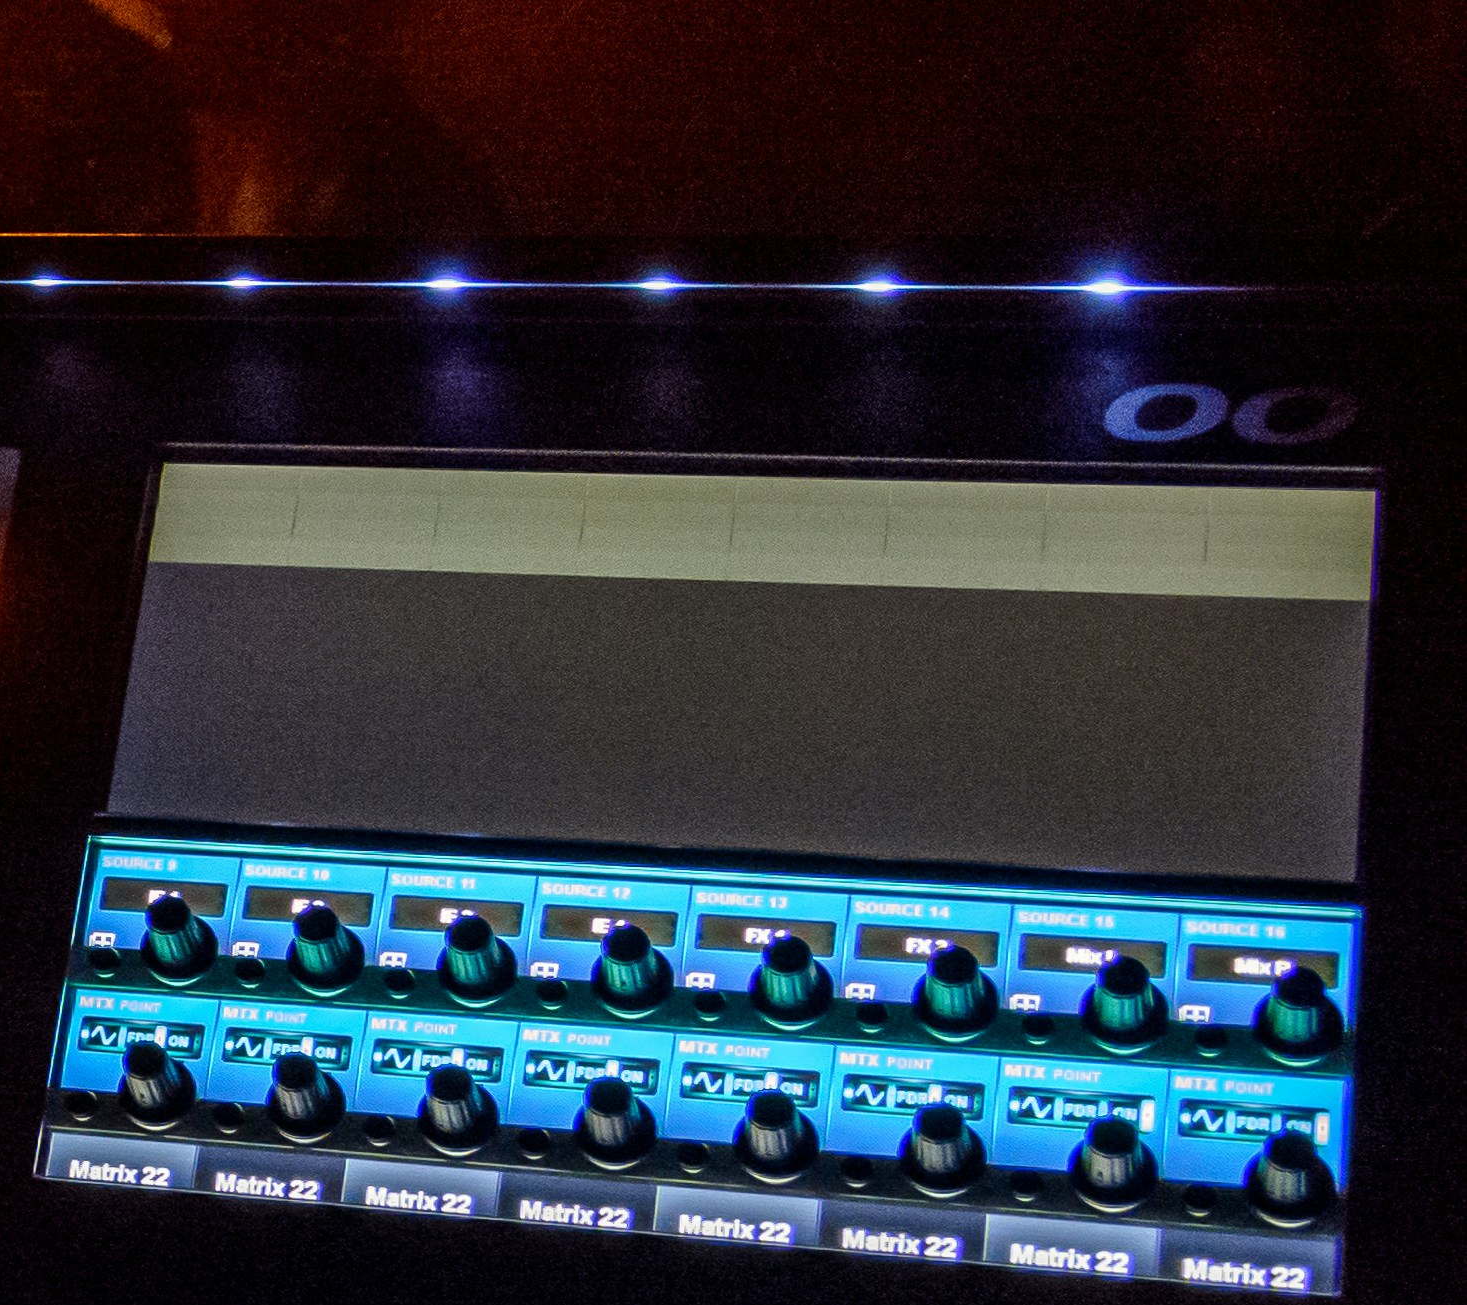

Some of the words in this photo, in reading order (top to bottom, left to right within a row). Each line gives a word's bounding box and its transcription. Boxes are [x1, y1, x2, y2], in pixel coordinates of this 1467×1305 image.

[102, 856, 165, 871] SOURCE
[167, 860, 178, 872] 9
[391, 874, 457, 890] SOURCE
[460, 877, 476, 890] 11
[696, 892, 764, 909] SOURCE
[769, 896, 788, 909] 13
[1186, 920, 1258, 938] SOURCE
[1265, 925, 1286, 939] 16
[371, 1017, 407, 1032] MTX
[414, 1022, 457, 1035] POINT
[679, 1040, 718, 1056] MTX
[725, 1045, 770, 1059] POINT
[839, 1051, 879, 1067] MTX
[887, 1056, 934, 1071] POINT
[69, 1159, 138, 1184] Matrix
[141, 1165, 171, 1187] 22
[215, 1172, 286, 1199] Matrix
[288, 1179, 319, 1201] 22
[364, 1185, 440, 1212] Matrix
[442, 1192, 473, 1215] 22
[519, 1199, 596, 1227] Matrix
[597, 1206, 630, 1230] 22
[678, 1213, 756, 1241] Matrix
[760, 1221, 792, 1245] 22
[842, 1227, 921, 1257] Matrix
[924, 1235, 958, 1260] 22
[1009, 1242, 1093, 1272] Matrix
[1095, 1250, 1130, 1275] 22
[1181, 1257, 1269, 1287] Matrix
[1271, 1264, 1306, 1290] 22
